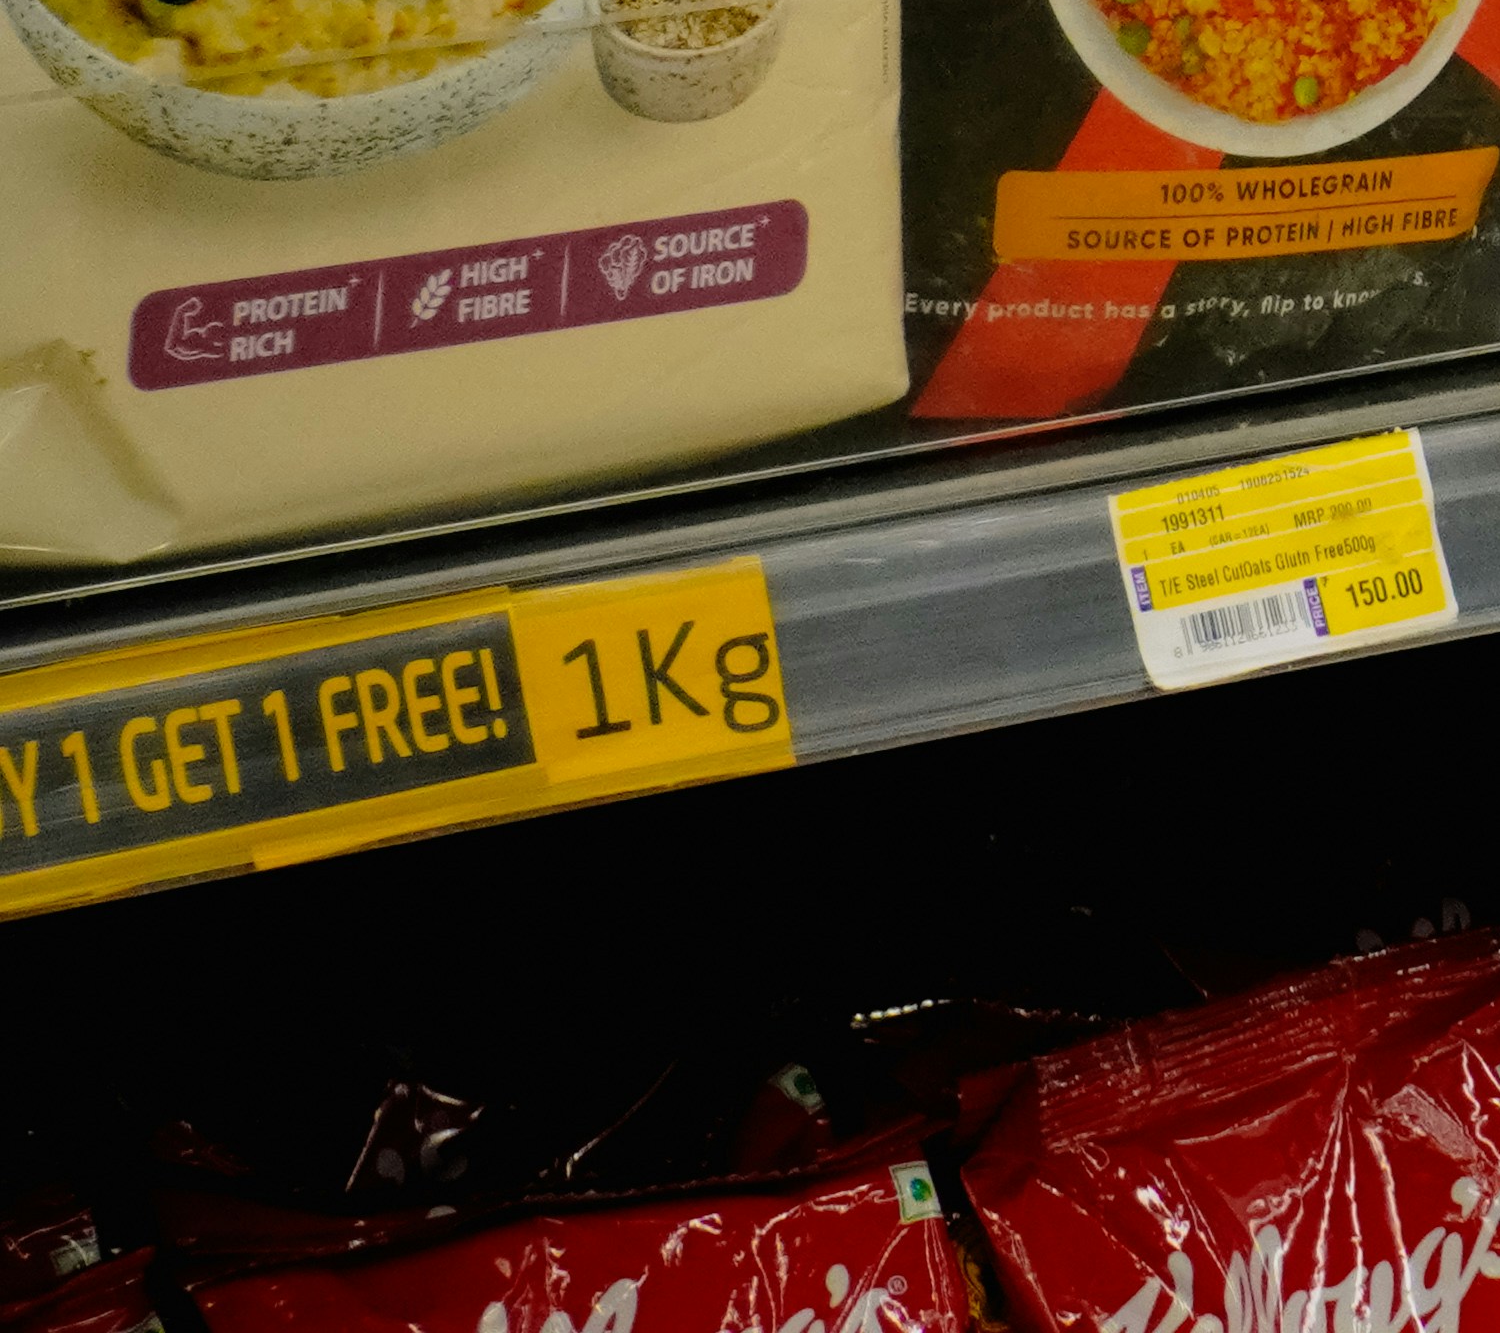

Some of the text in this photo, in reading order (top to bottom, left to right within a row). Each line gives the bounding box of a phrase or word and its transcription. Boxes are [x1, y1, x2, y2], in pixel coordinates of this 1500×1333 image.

[1159, 169, 1394, 206] 100% WHOLEGRAIN
[1066, 206, 1460, 252] SOURCE OF PROTEIN HIGH FIBRE
[229, 257, 755, 364] RICH FIBRE OF IRON
[902, 291, 978, 323] Every
[986, 297, 1094, 323] product
[1102, 298, 1152, 322] has
[1160, 302, 1177, 321] a
[1160, 504, 1226, 532] 1991311
[1293, 511, 1326, 529] MRP
[1160, 578, 1183, 597] T/E
[1187, 571, 1221, 591] Steel
[1344, 568, 1424, 608] 150.00
[1306, 586, 1326, 629] PRICE
[61, 730, 102, 826] 1
[120, 699, 243, 813] GET
[262, 688, 301, 784] 1
[316, 647, 509, 773] FREE!
[560, 619, 782, 741] 1Kg
